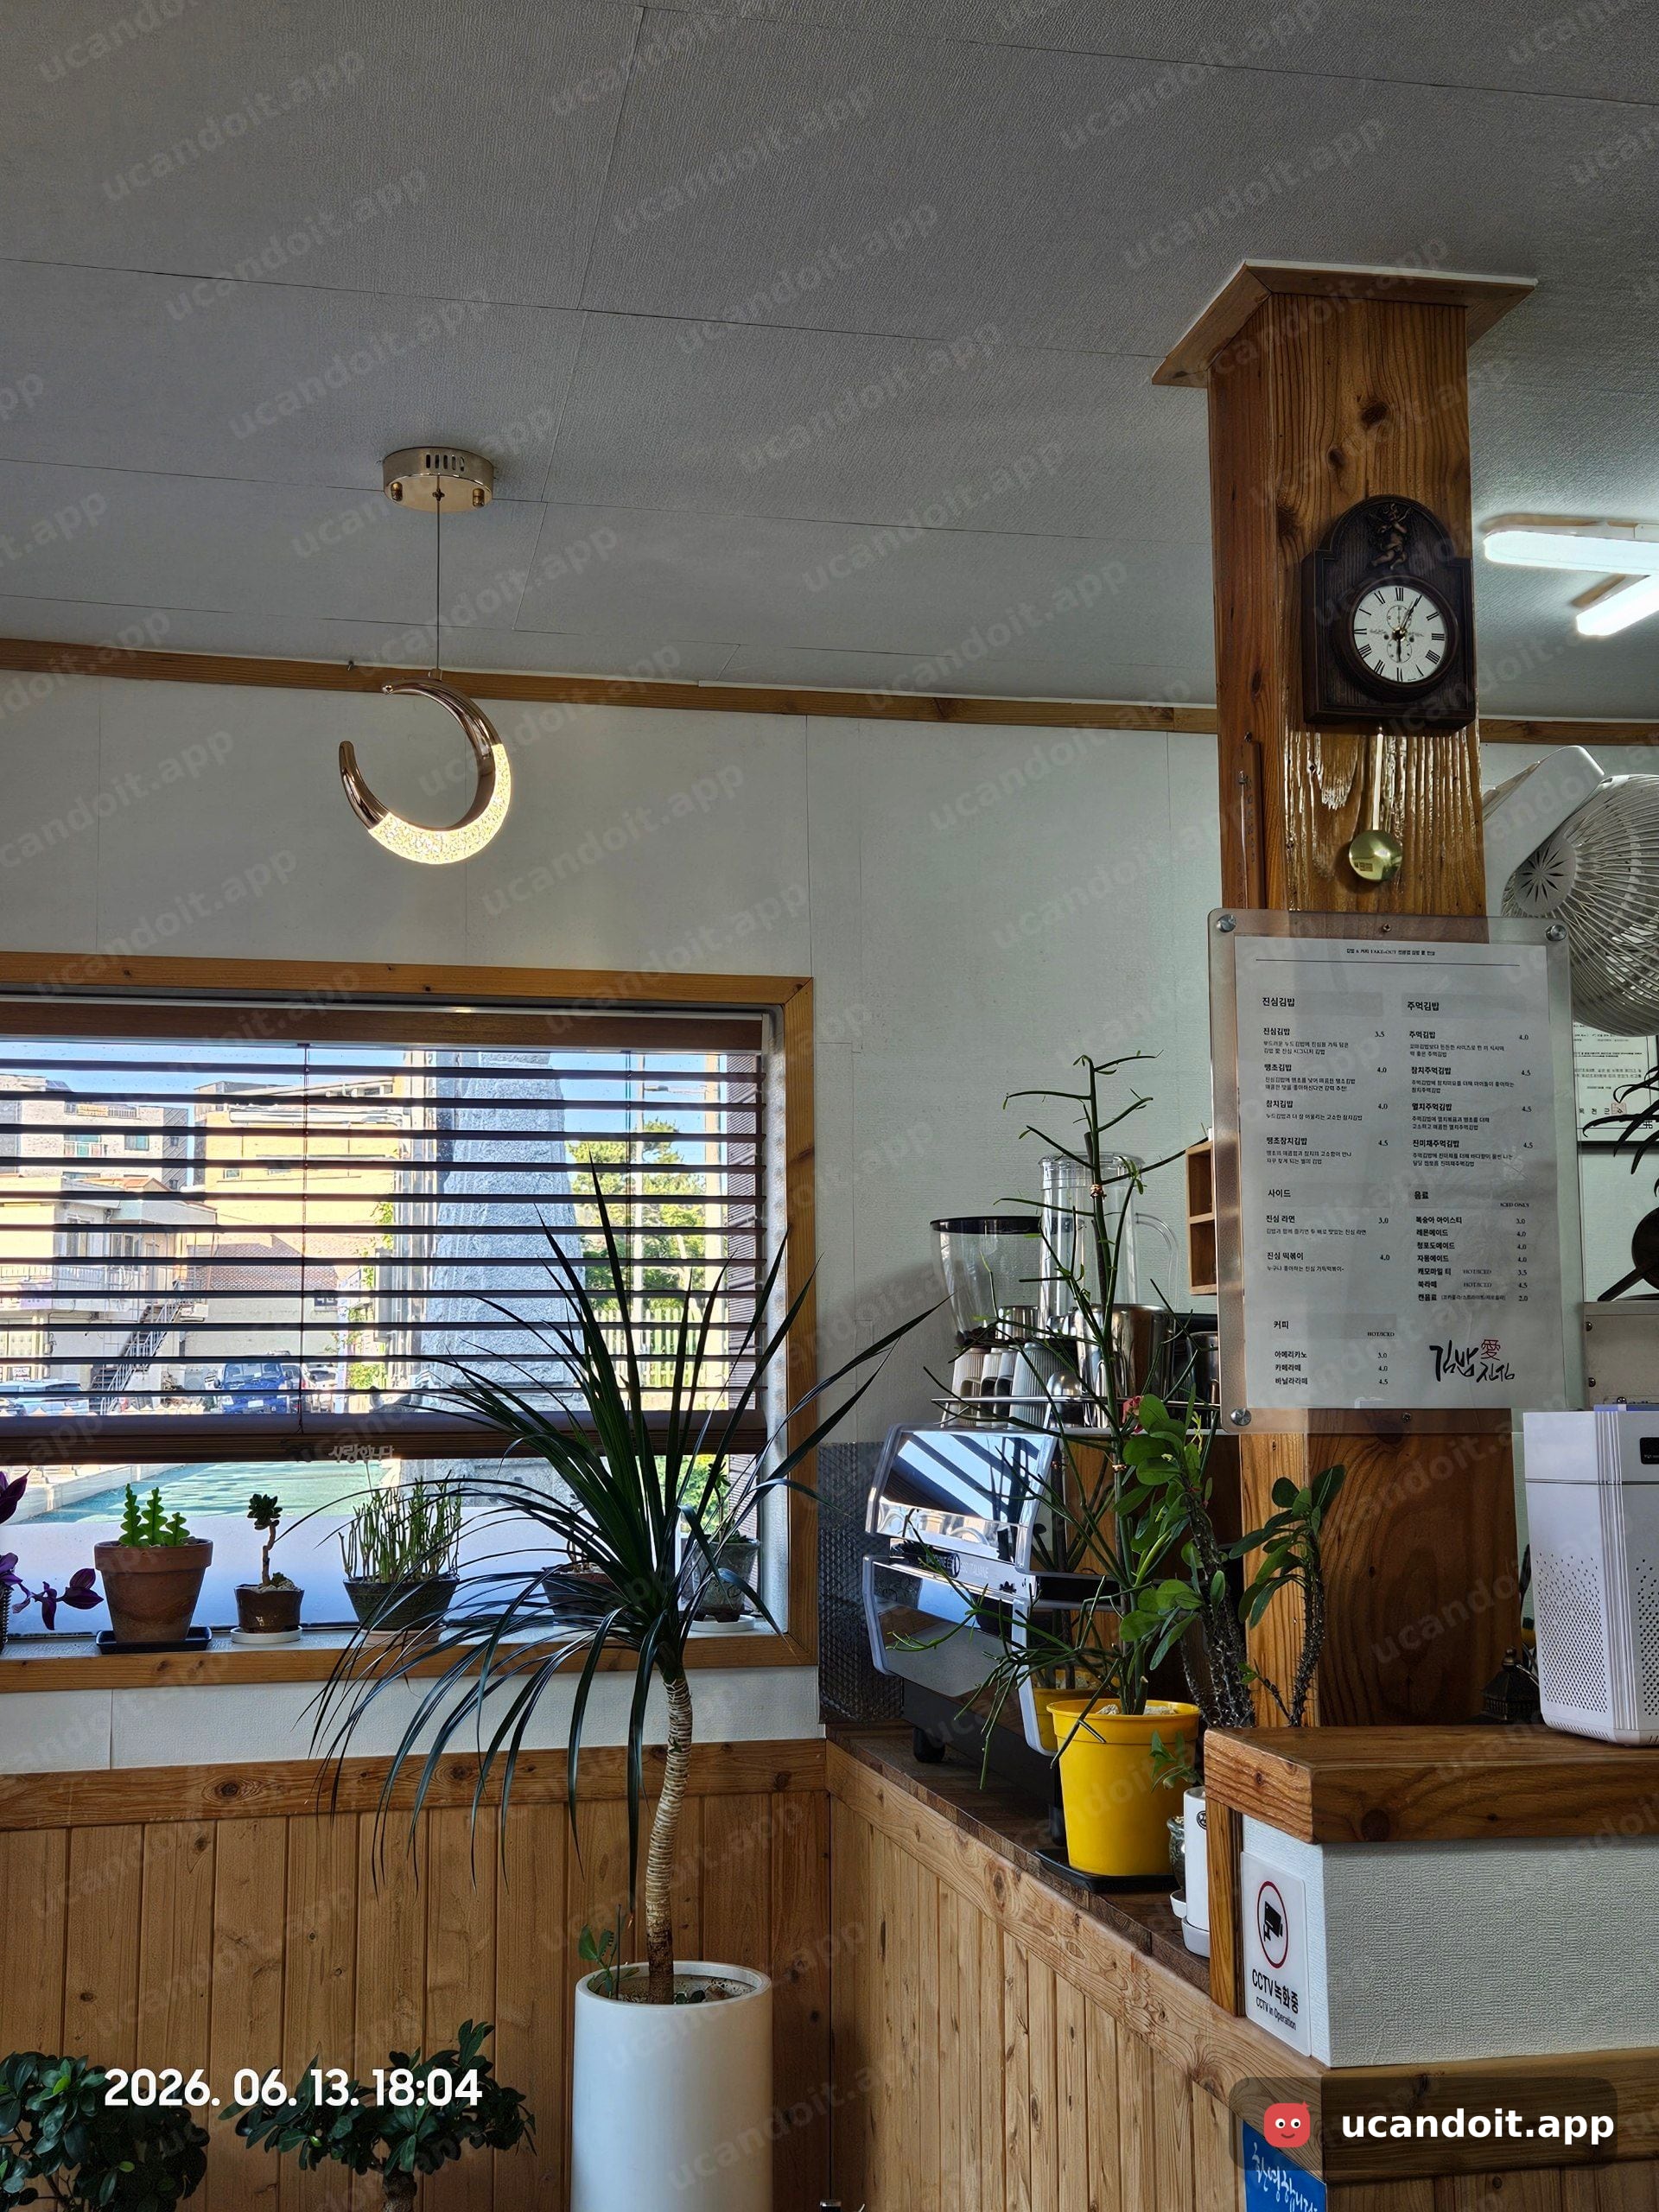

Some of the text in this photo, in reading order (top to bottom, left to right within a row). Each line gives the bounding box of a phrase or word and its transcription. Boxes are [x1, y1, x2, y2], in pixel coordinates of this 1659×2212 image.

[1262, 997, 1295, 1007] 진심김밥
[1263, 1027, 1290, 1036] 진심김밥
[1268, 1189, 1291, 1198] 사이드
[1274, 1320, 1289, 1329] 커피
[1256, 1997, 1268, 2012] CCTV
[1274, 2008, 1296, 2031] Operation
